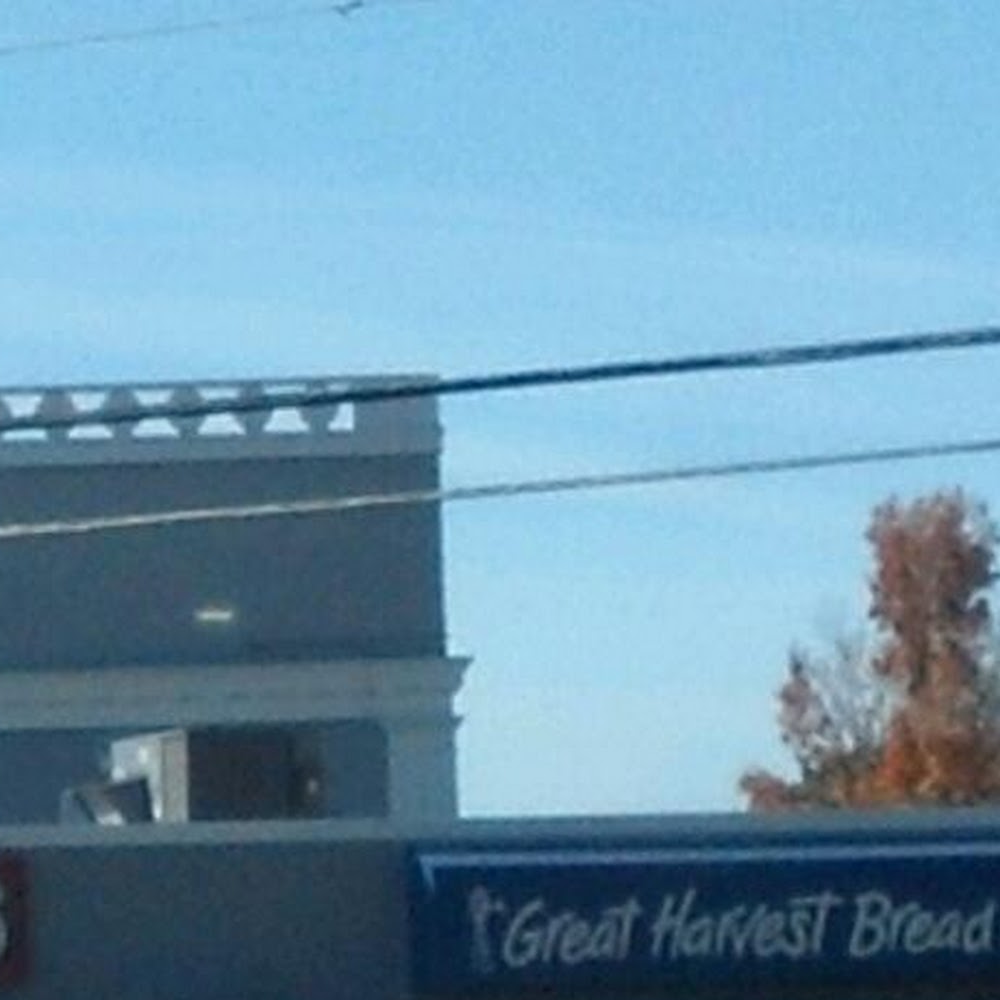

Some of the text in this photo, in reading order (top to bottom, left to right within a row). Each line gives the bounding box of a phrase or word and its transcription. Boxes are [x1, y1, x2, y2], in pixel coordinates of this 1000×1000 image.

[501, 888, 997, 968] Great Harvest Bread
